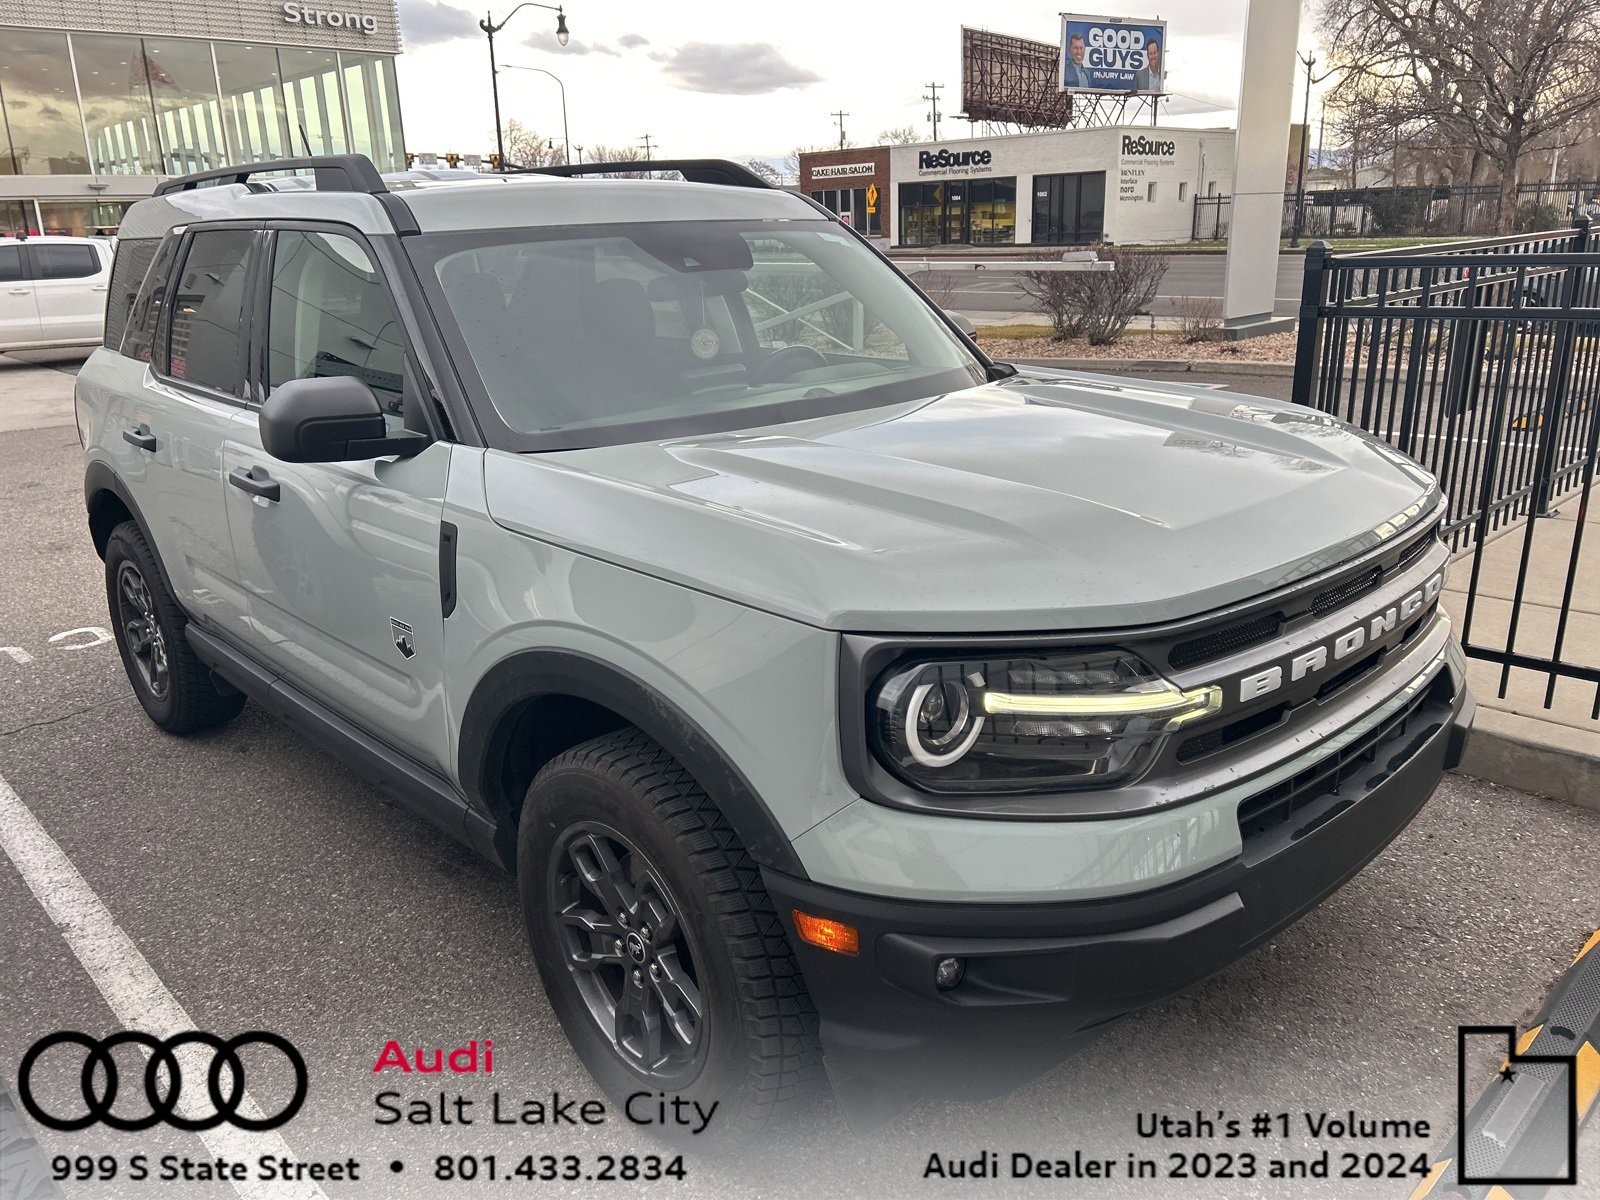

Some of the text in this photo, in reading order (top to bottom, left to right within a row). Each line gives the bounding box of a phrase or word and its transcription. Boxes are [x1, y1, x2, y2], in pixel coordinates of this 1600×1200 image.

[283, 2, 378, 35] Strong
[1088, 27, 1145, 50] GOOD
[1088, 48, 1144, 70] GUYS
[1093, 71, 1135, 80] INJURY LAW
[1121, 135, 1175, 156] ReSource
[918, 149, 992, 169] ReSource
[831, 167, 848, 176] HAIR
[849, 165, 873, 174] SALON
[918, 166, 992, 177] Commercial Flooring Systems
[1240, 574, 1442, 702] BRONCO
